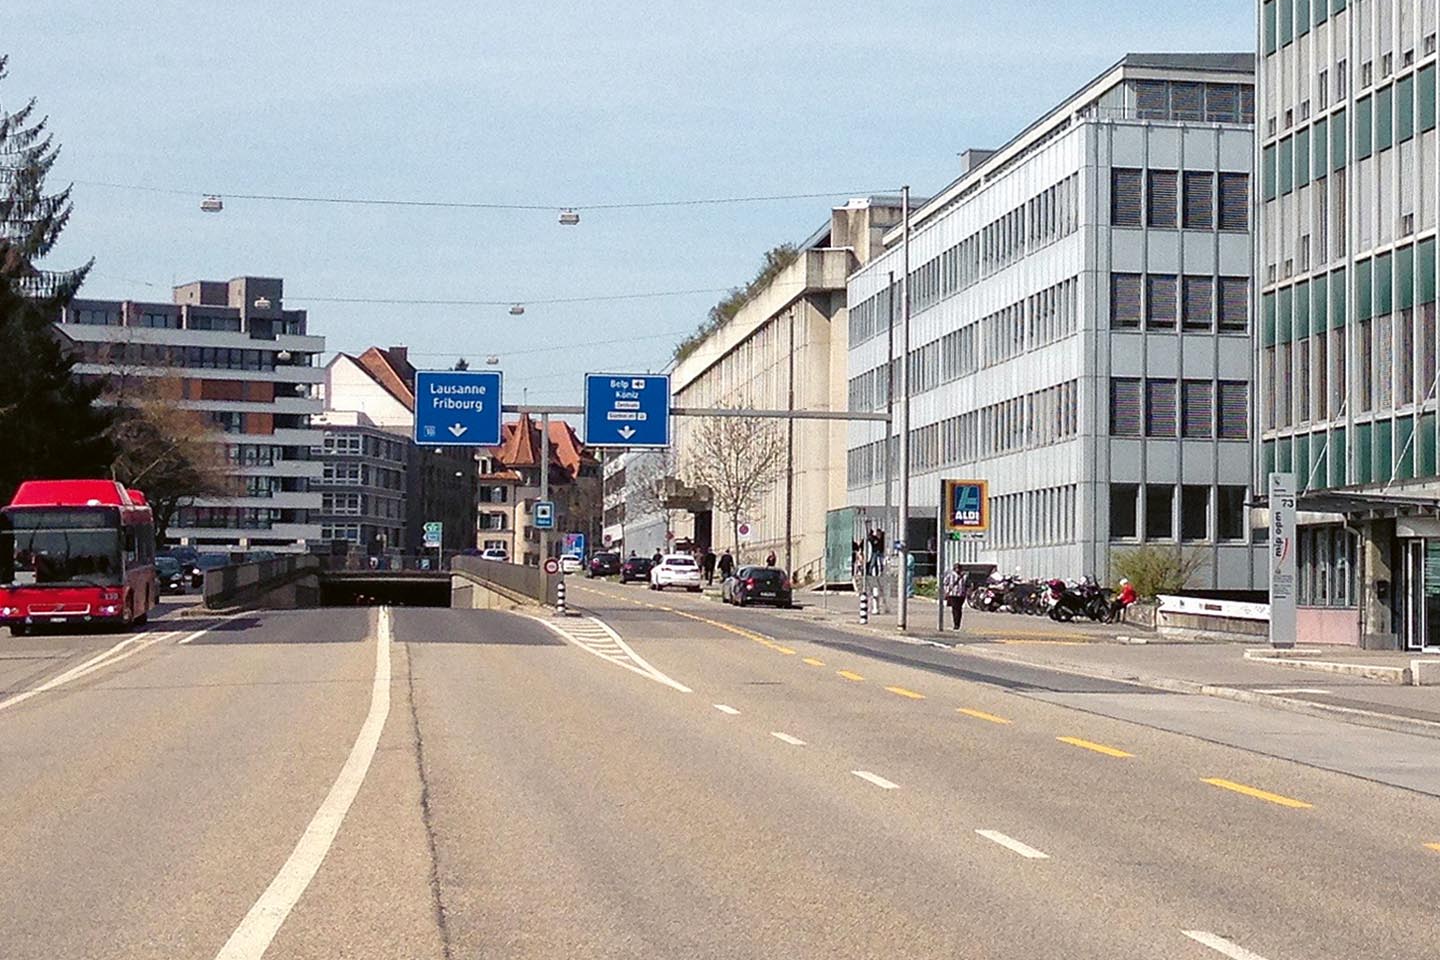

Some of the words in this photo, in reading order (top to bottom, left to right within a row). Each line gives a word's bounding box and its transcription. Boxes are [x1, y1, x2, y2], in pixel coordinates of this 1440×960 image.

[430, 383, 486, 395] Lausanne
[610, 379, 629, 390] Belp
[433, 397, 483, 412] Fribourg
[1281, 499, 1294, 508] 73
[955, 511, 980, 521] ALDI
